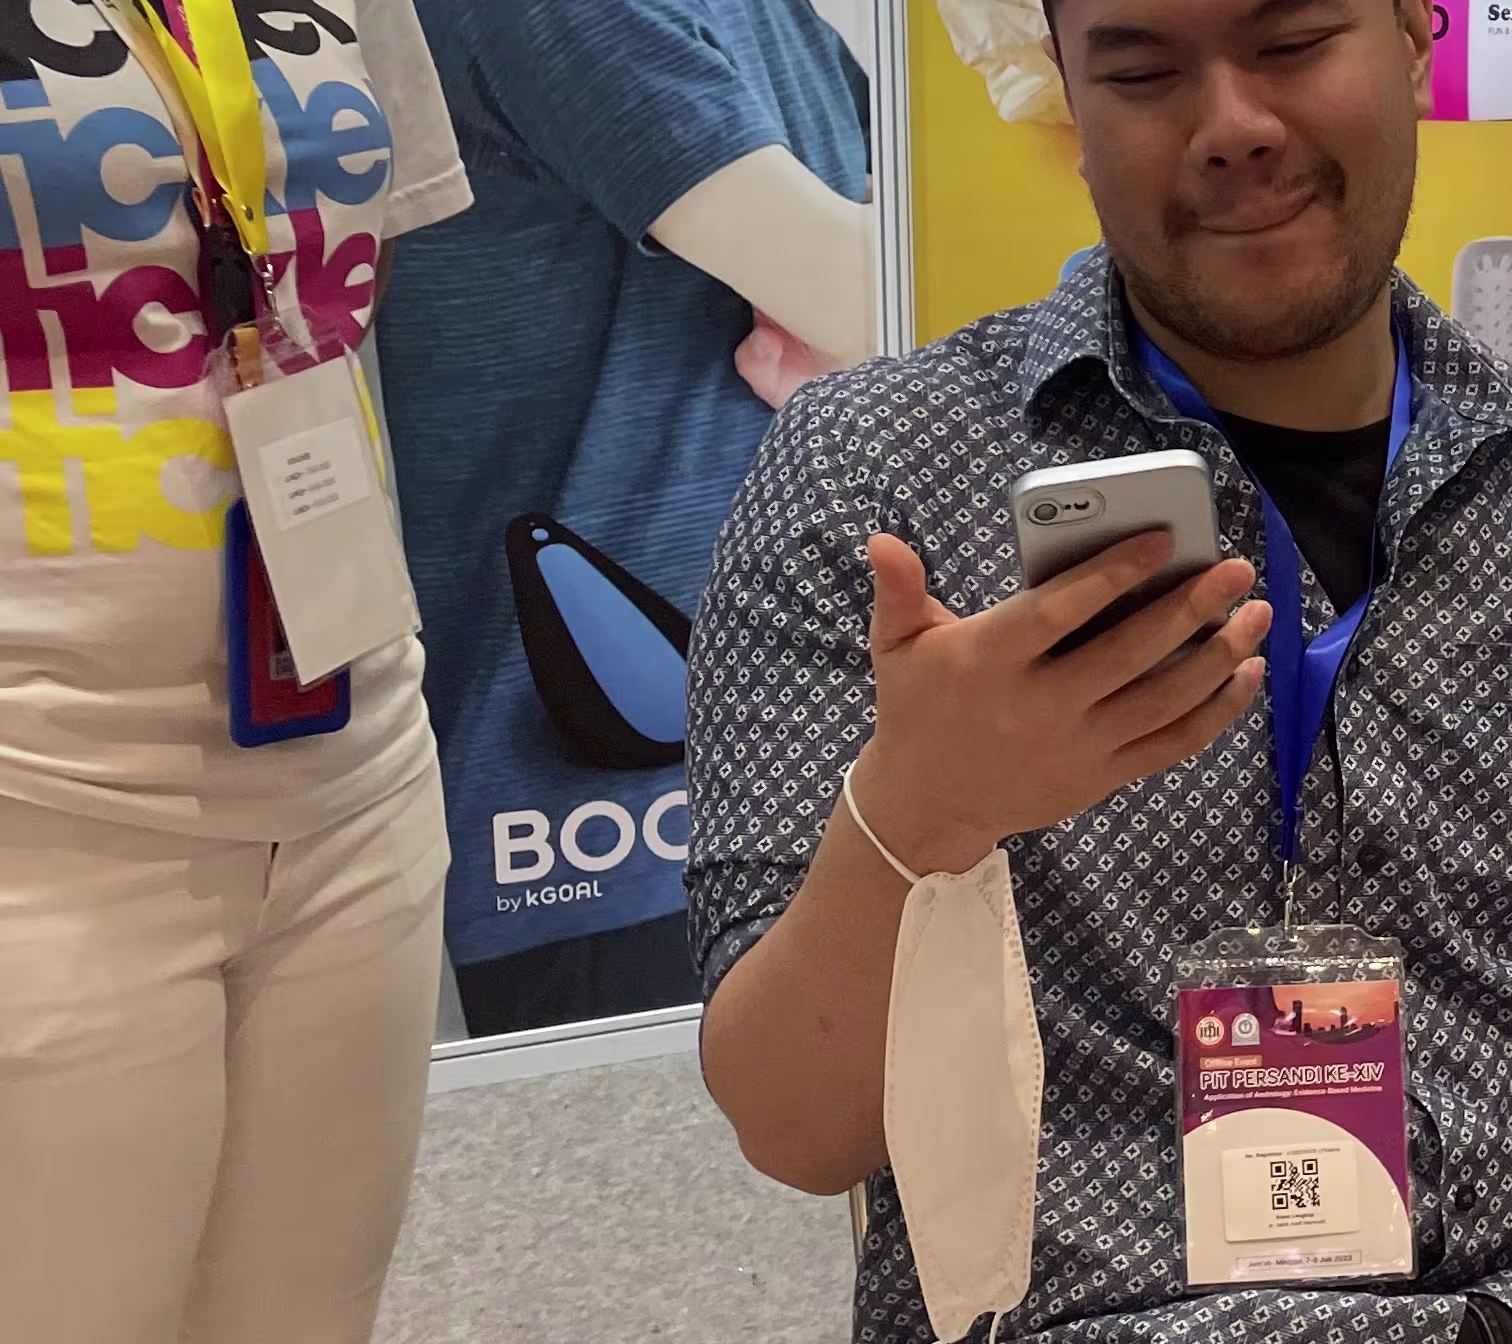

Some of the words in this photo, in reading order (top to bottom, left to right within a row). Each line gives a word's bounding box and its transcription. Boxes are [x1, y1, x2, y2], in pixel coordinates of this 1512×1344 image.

[497, 896, 521, 912] by
[1200, 1070, 1229, 1090] PIT
[1233, 1066, 1320, 1088] PERSANDI
[1325, 1062, 1385, 1083] KE-XIV
